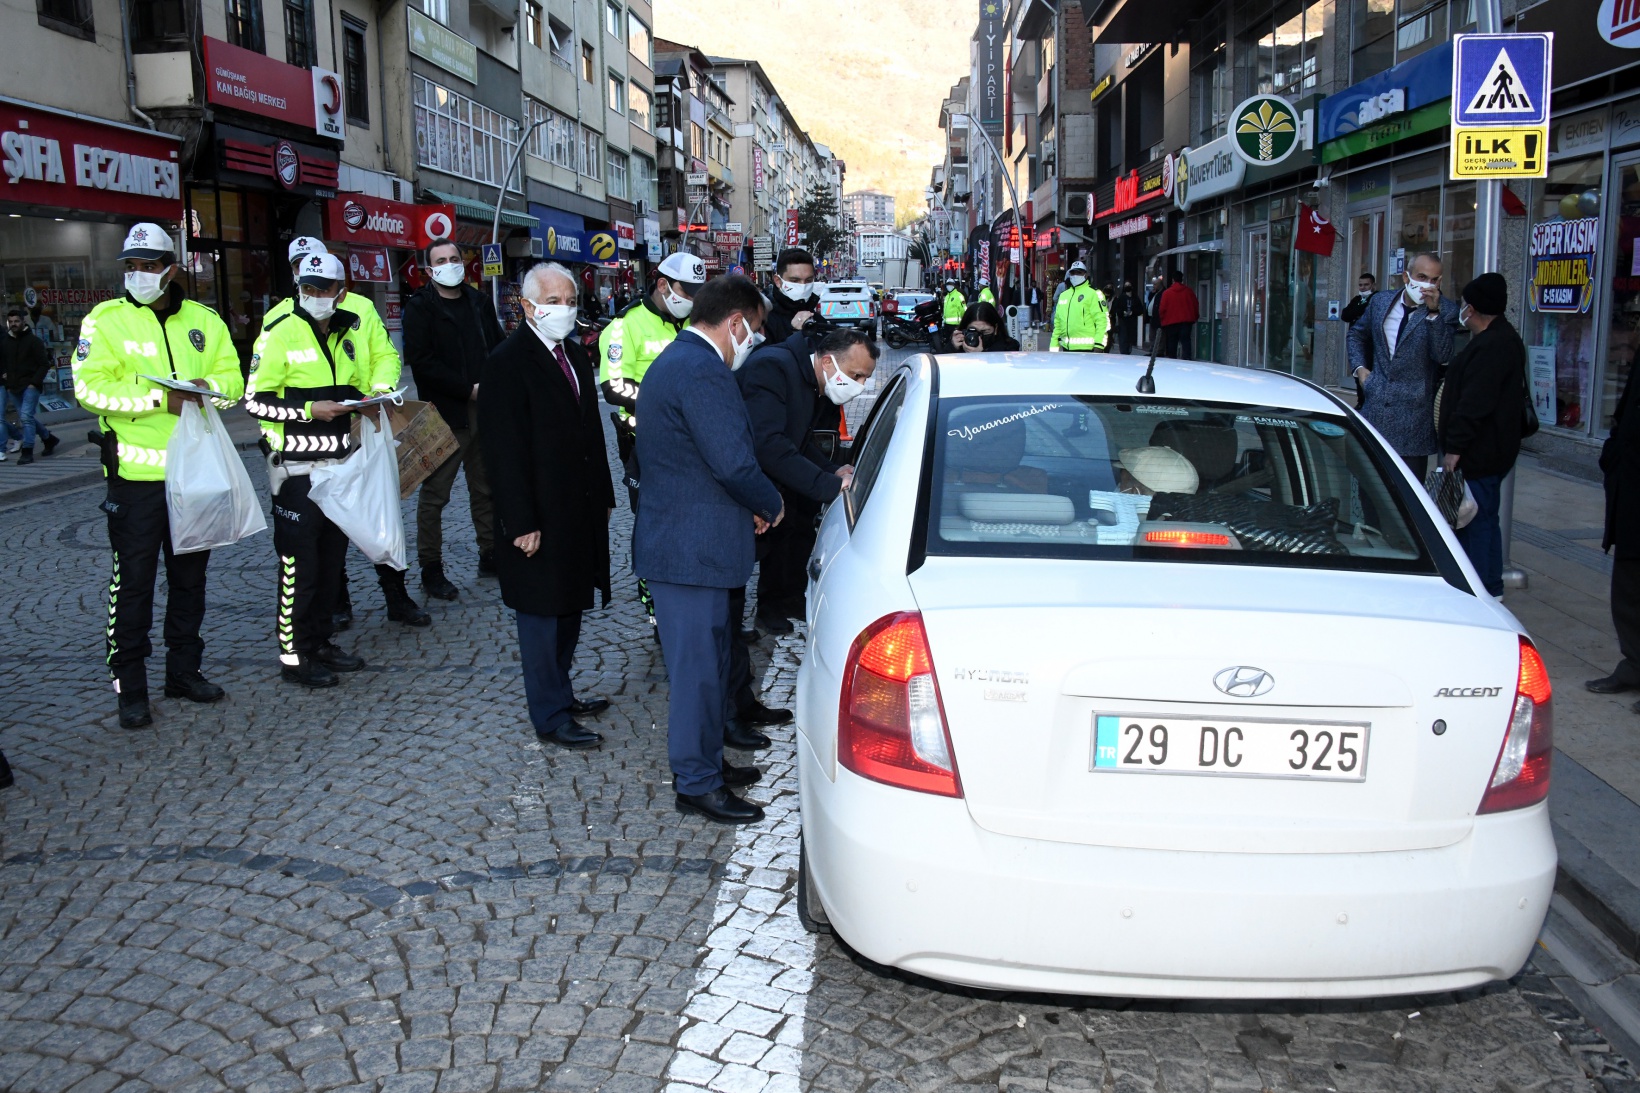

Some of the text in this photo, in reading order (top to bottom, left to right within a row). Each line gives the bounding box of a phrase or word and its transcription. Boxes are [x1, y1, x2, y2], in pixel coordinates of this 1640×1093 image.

[216, 80, 233, 96] KAN
[258, 92, 287, 110] MERKEZİ
[1465, 135, 1511, 155] İLK
[1, 120, 180, 200] ŞİFA ECZANESİ
[362, 211, 404, 235] odafone
[788, 220, 796, 246] CHP
[557, 234, 581, 252] TURKCELL
[1531, 219, 1598, 256] SÜPER KASIM
[1555, 288, 1573, 303] KASIM
[286, 348, 318, 365] POLİS
[954, 667, 1029, 684] HYUNDAI
[1433, 687, 1503, 698] ACCENT
[1098, 724, 1359, 772] TR 29 DC 325
